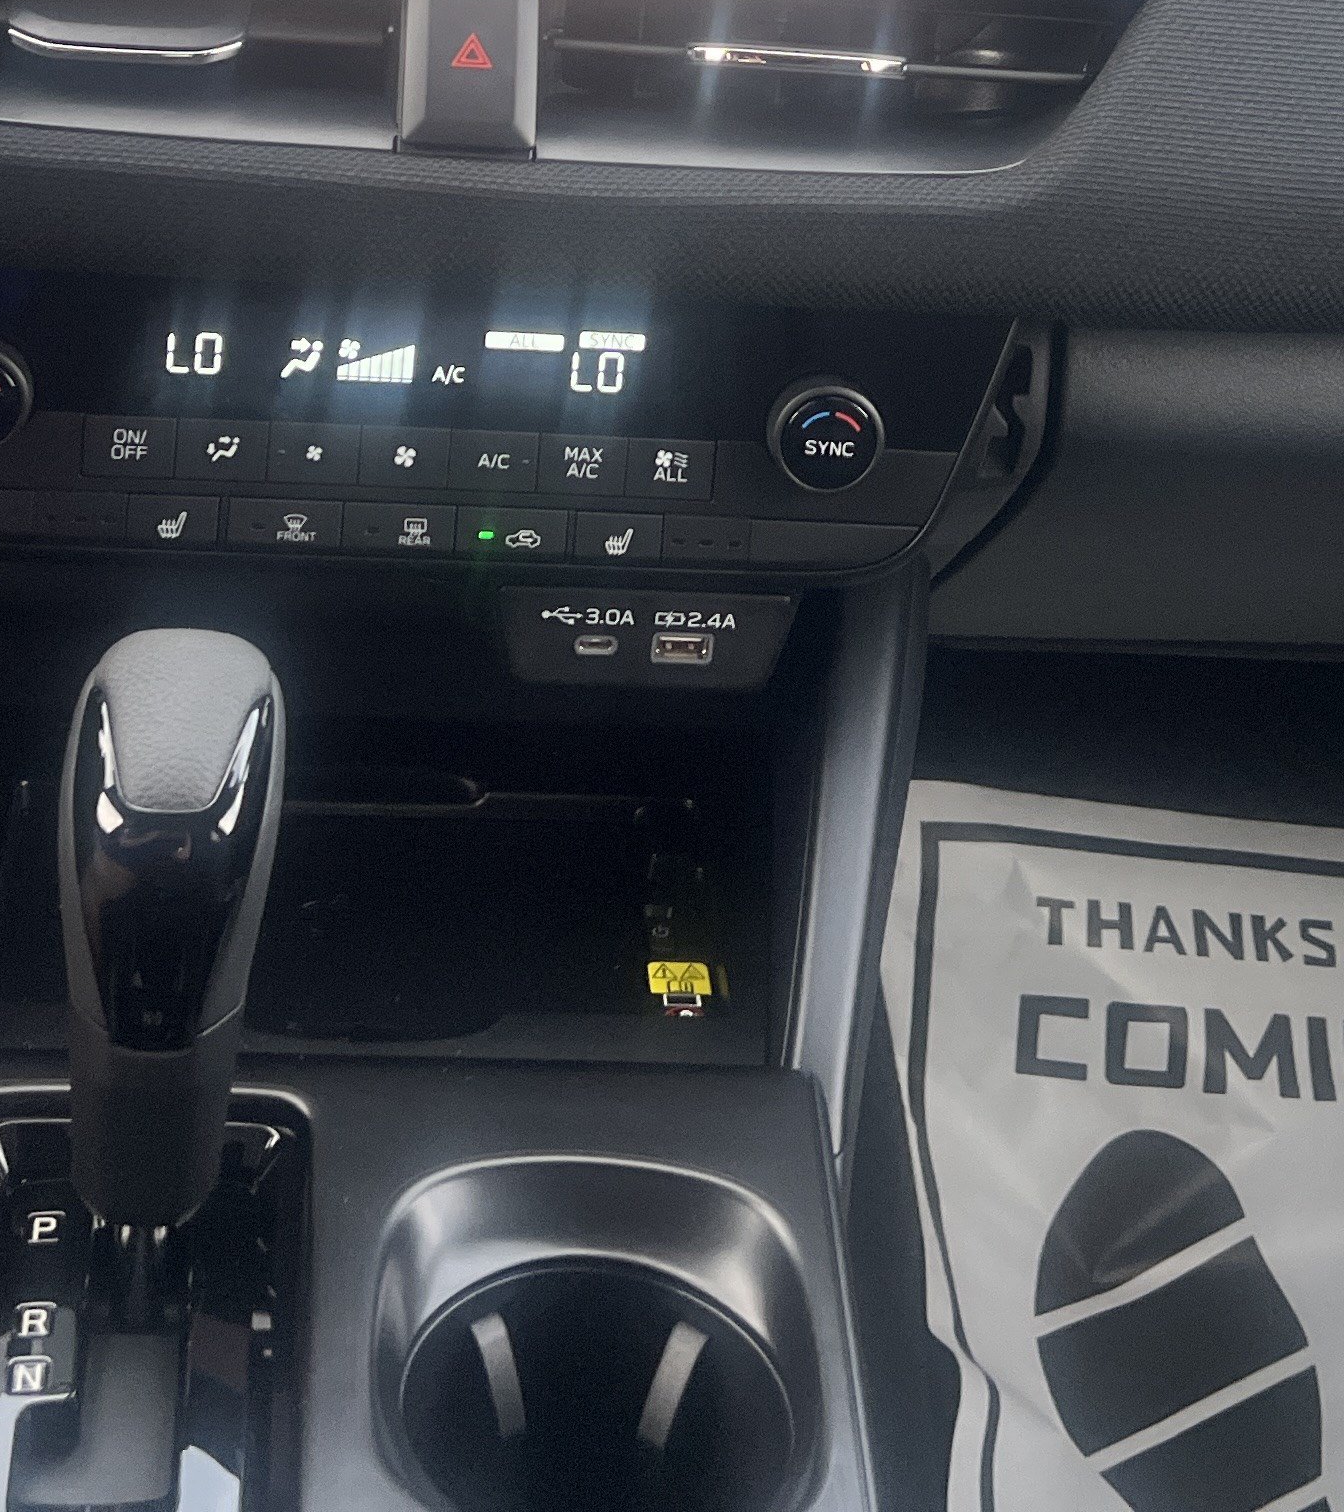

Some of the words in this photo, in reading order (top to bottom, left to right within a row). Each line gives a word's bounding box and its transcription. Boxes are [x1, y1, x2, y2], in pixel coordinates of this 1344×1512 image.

[510, 334, 538, 348] ALL
[589, 333, 635, 349] SYNC
[166, 331, 223, 375] LO
[432, 365, 465, 384] A/C
[570, 351, 625, 393] LO
[113, 428, 148, 444] ON/
[111, 444, 148, 461] OFF
[564, 446, 604, 463] MAX
[804, 439, 855, 458] SYNC
[478, 453, 510, 470] A/C
[566, 463, 600, 479] A/C
[653, 467, 688, 483] ALL
[276, 530, 317, 543] FRONT
[398, 534, 431, 546] REAR
[586, 607, 635, 627] 3.0A
[688, 611, 736, 630] 2.4A
[1035, 895, 1337, 968] THANKS
[33, 1216, 57, 1241] P
[21, 1308, 49, 1337] R
[14, 1364, 44, 1391] N
